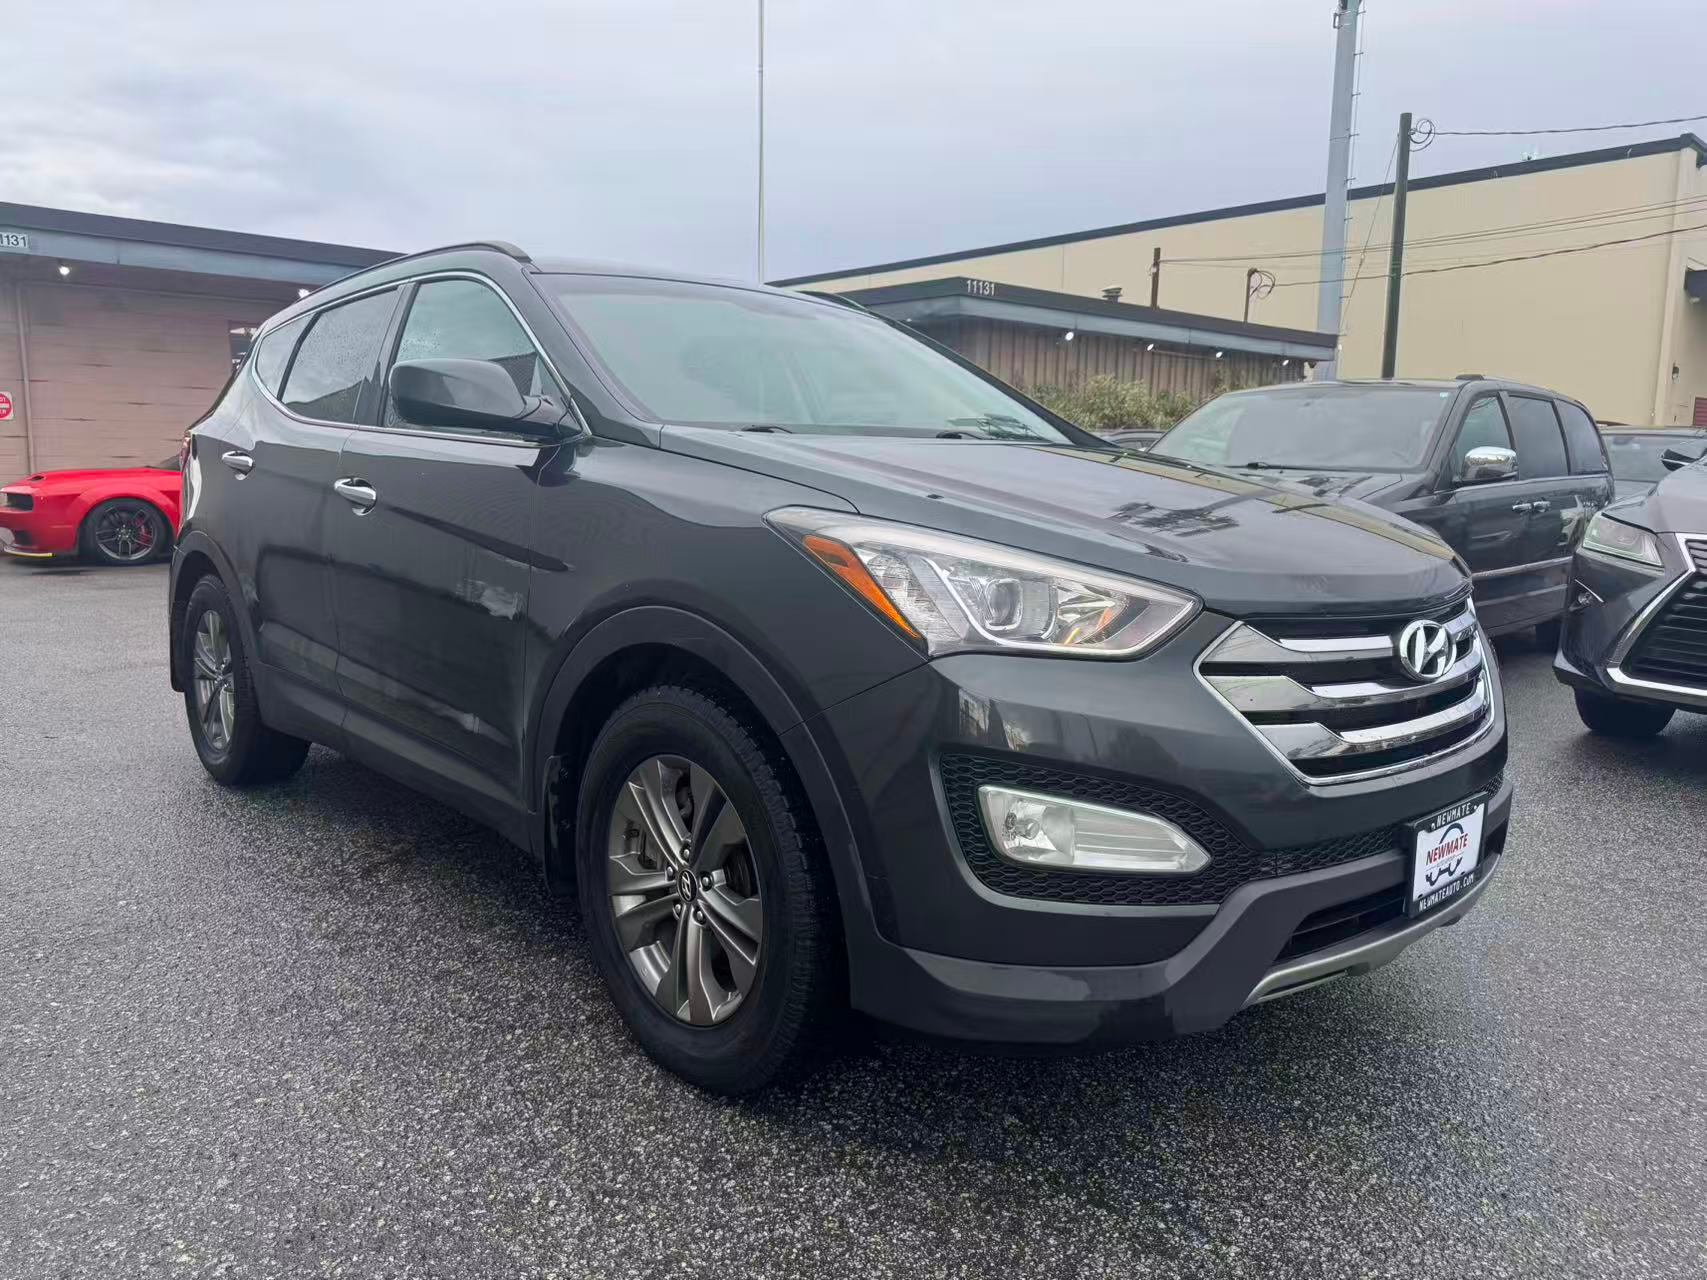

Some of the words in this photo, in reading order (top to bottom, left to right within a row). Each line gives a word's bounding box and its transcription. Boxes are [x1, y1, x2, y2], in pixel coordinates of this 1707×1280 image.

[966, 280, 995, 296] 11131
[1436, 803, 1471, 828] NEWMATE
[1426, 833, 1468, 865] NEWMATE
